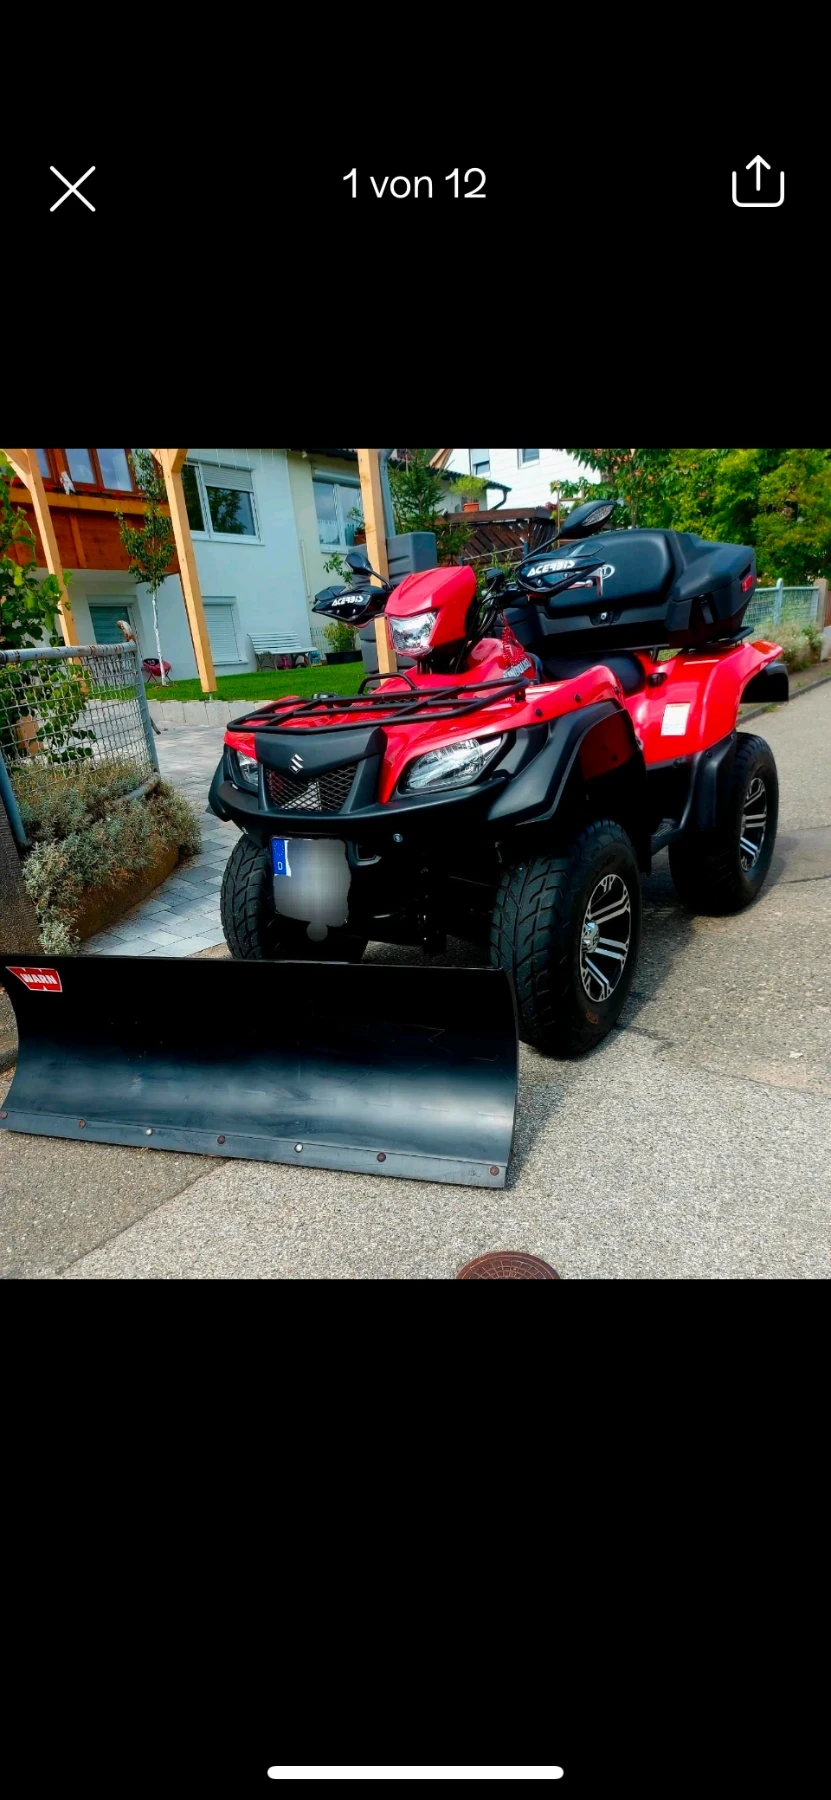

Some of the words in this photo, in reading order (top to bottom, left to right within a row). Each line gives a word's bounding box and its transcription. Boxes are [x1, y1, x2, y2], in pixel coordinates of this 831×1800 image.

[526, 560, 576, 577] ACERBIS
[331, 595, 364, 607] ACERBIS
[20, 973, 58, 985] WARN
